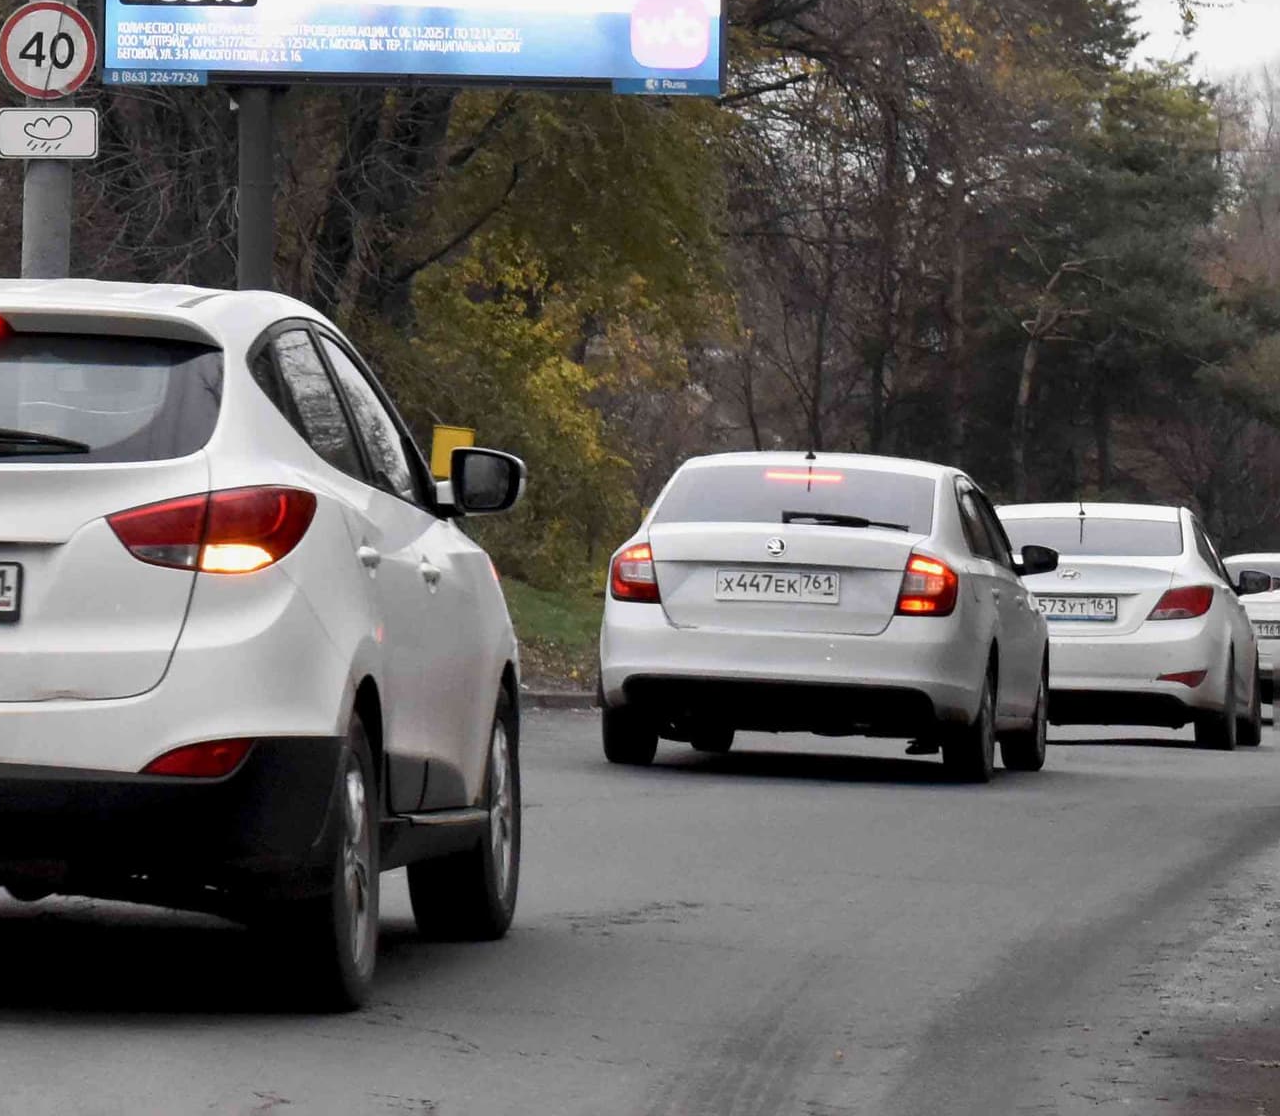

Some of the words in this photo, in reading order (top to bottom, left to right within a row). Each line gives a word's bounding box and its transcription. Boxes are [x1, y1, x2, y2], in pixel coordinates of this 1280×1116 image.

[19, 31, 75, 70] 40
[112, 72, 119, 82] 8
[722, 574, 798, 594] Х447ЕК
[803, 575, 834, 590] 761
[1038, 599, 1086, 613] 573УТ
